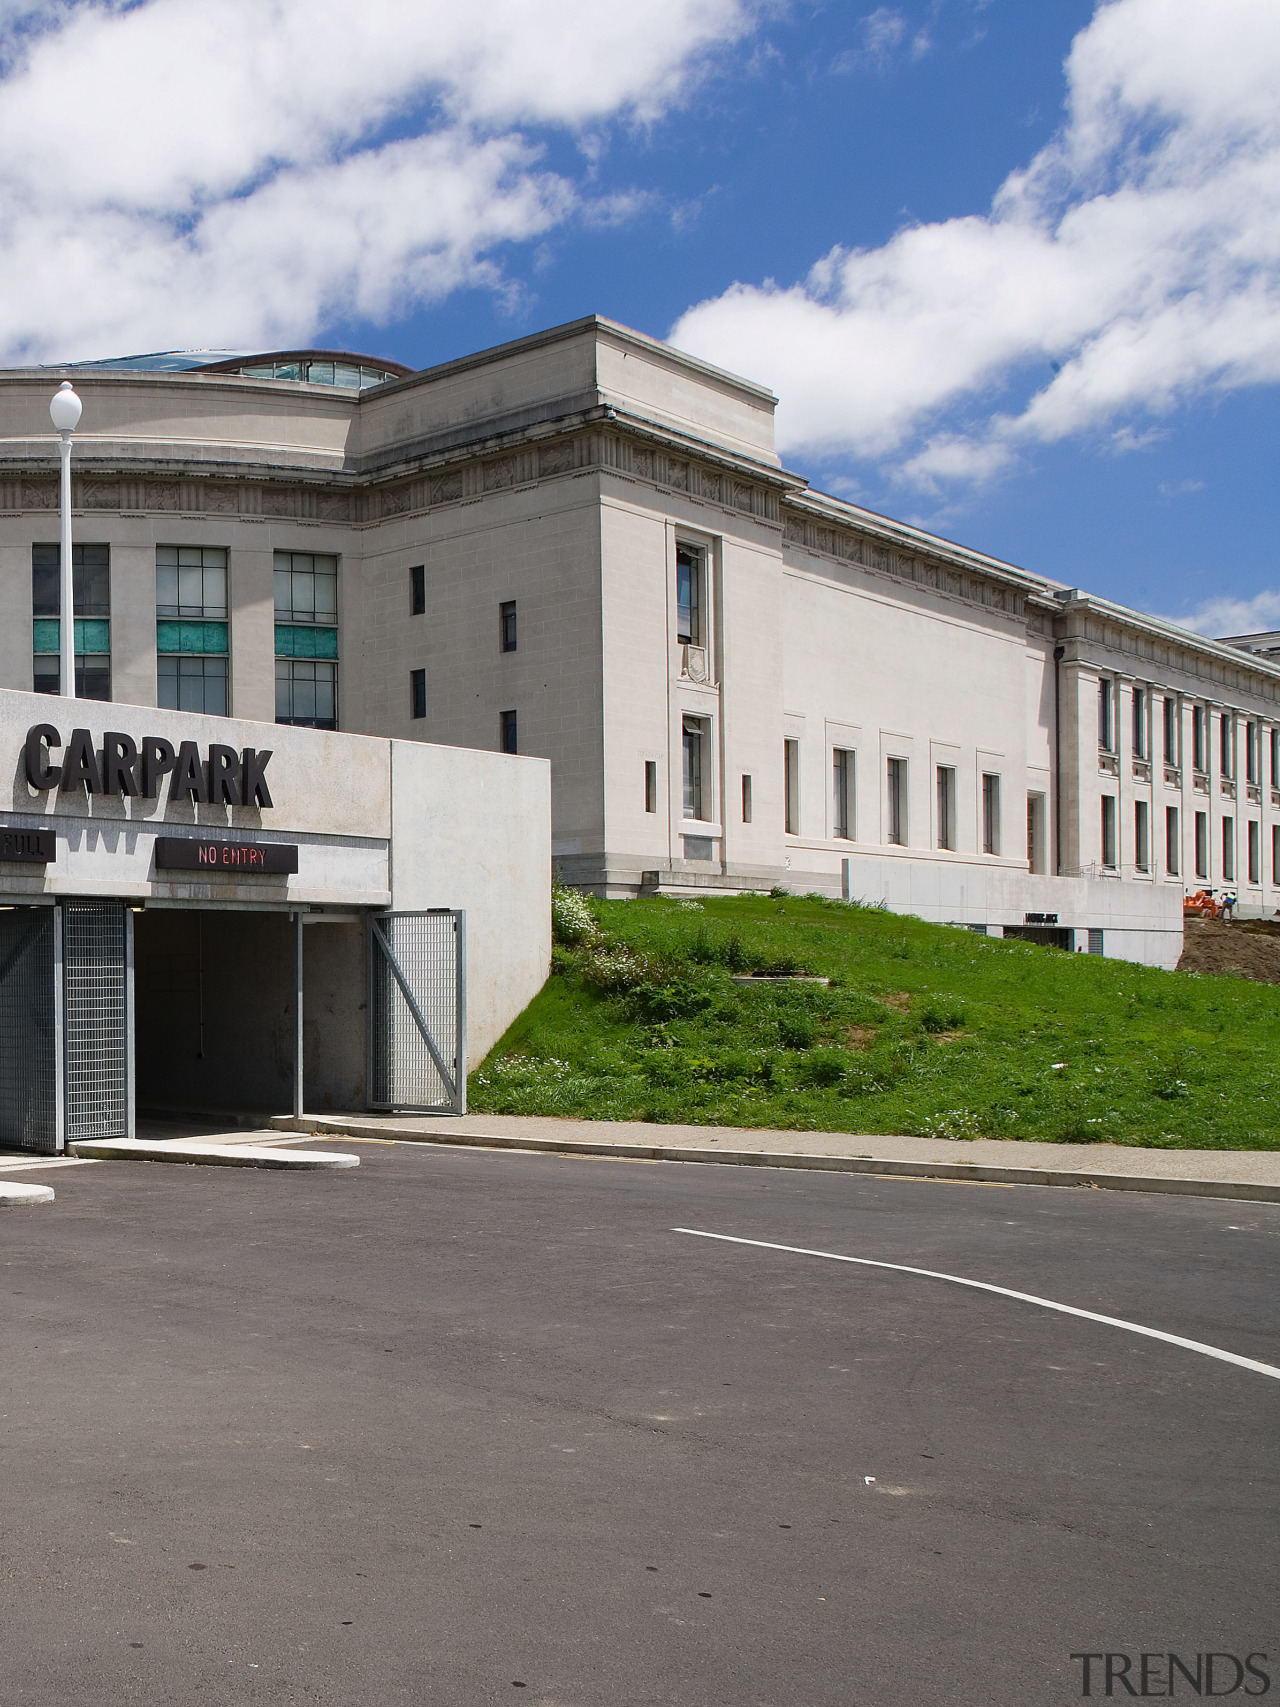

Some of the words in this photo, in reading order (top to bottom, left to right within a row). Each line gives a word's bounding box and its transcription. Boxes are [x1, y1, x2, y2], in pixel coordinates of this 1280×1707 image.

[26, 723, 274, 808] CARPARK
[3, 834, 44, 855] FULL
[199, 846, 217, 864] NO
[222, 847, 266, 866] ENTRY
